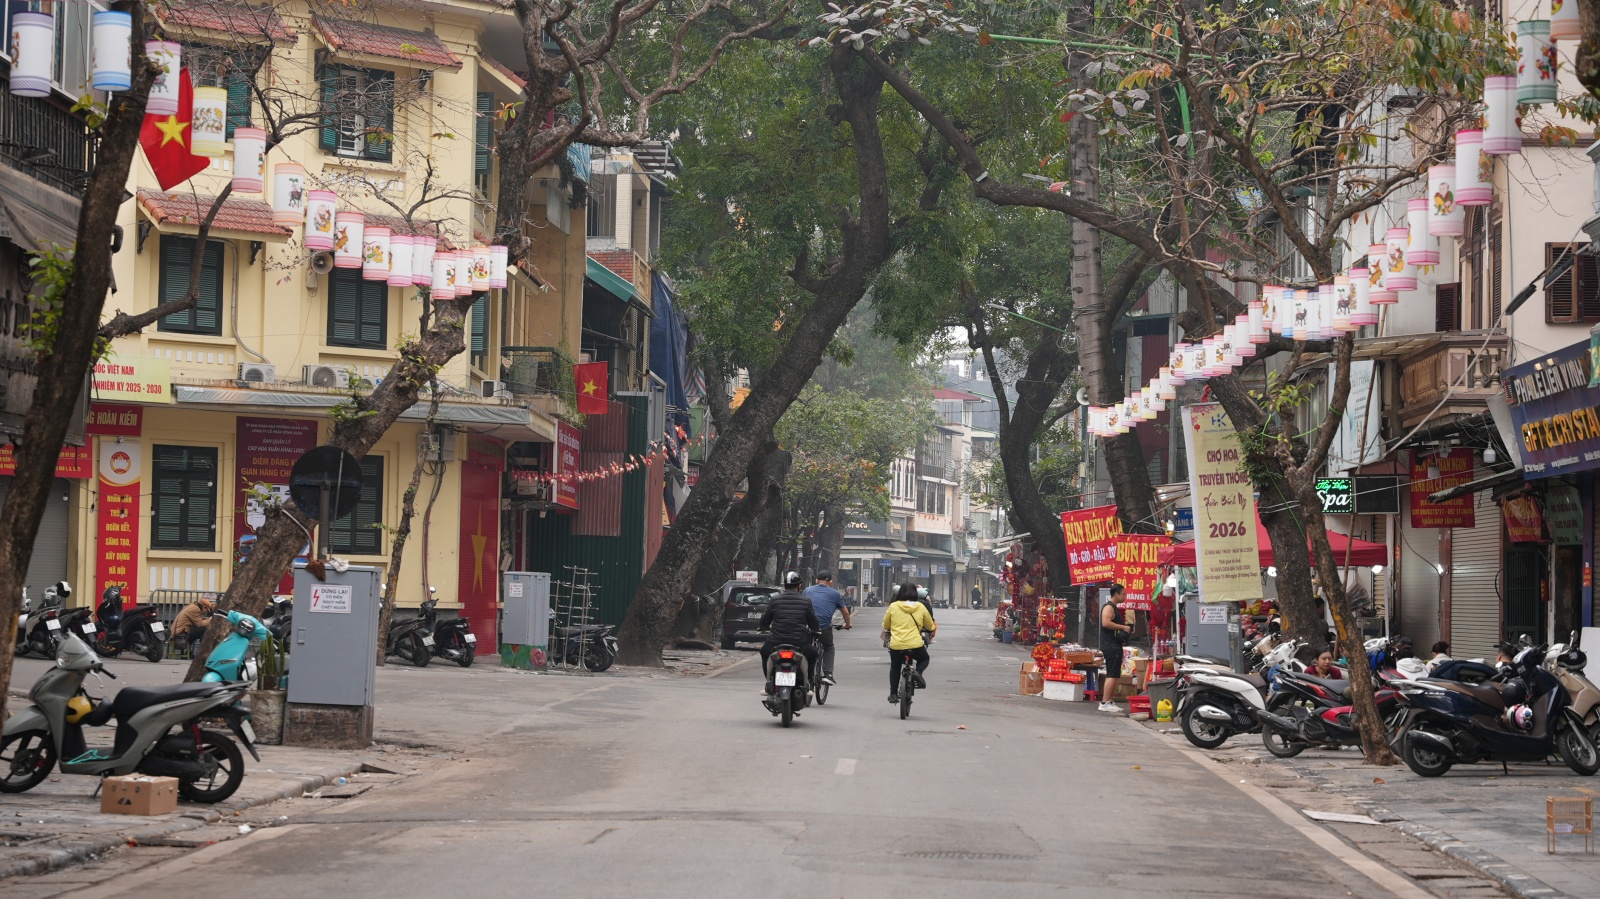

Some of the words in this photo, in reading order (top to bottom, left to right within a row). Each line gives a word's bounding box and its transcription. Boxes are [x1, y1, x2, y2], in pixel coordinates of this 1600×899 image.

[94, 363, 105, 374] UỐC
[107, 363, 119, 376] VIỆT
[122, 366, 134, 375] NAM
[1559, 359, 1586, 390] VINH
[97, 380, 115, 392] NHIỆM
[117, 382, 124, 391] KỲ
[126, 382, 141, 392] 2025
[147, 384, 162, 394] 2030
[97, 410, 116, 425] HOÀN
[119, 410, 137, 426] KIẾM
[1522, 421, 1544, 453] GIFT
[1542, 417, 1553, 448] &
[1207, 449, 1222, 464] CHỢ
[1223, 449, 1239, 461] HOA
[1199, 468, 1224, 486] TRUYỀN
[1317, 490, 1350, 510] Spa
[106, 522, 119, 532] ĐOÀN
[121, 522, 131, 532] KẾT,
[1065, 516, 1084, 545] BÚN
[1084, 512, 1105, 543] RIÊU
[1209, 521, 1246, 538] 2026
[105, 537, 119, 546] SÁNG
[1116, 537, 1139, 562] BÚN
[106, 552, 115, 560] XÂY
[117, 553, 130, 561] DỰNG
[1070, 549, 1078, 564] BÒ
[1081, 547, 1090, 563] GIÒ
[1093, 545, 1105, 563] ĐẬU
[1108, 543, 1117, 558] TÓ
[109, 566, 116, 574] HÀ
[117, 566, 126, 576] NỘI
